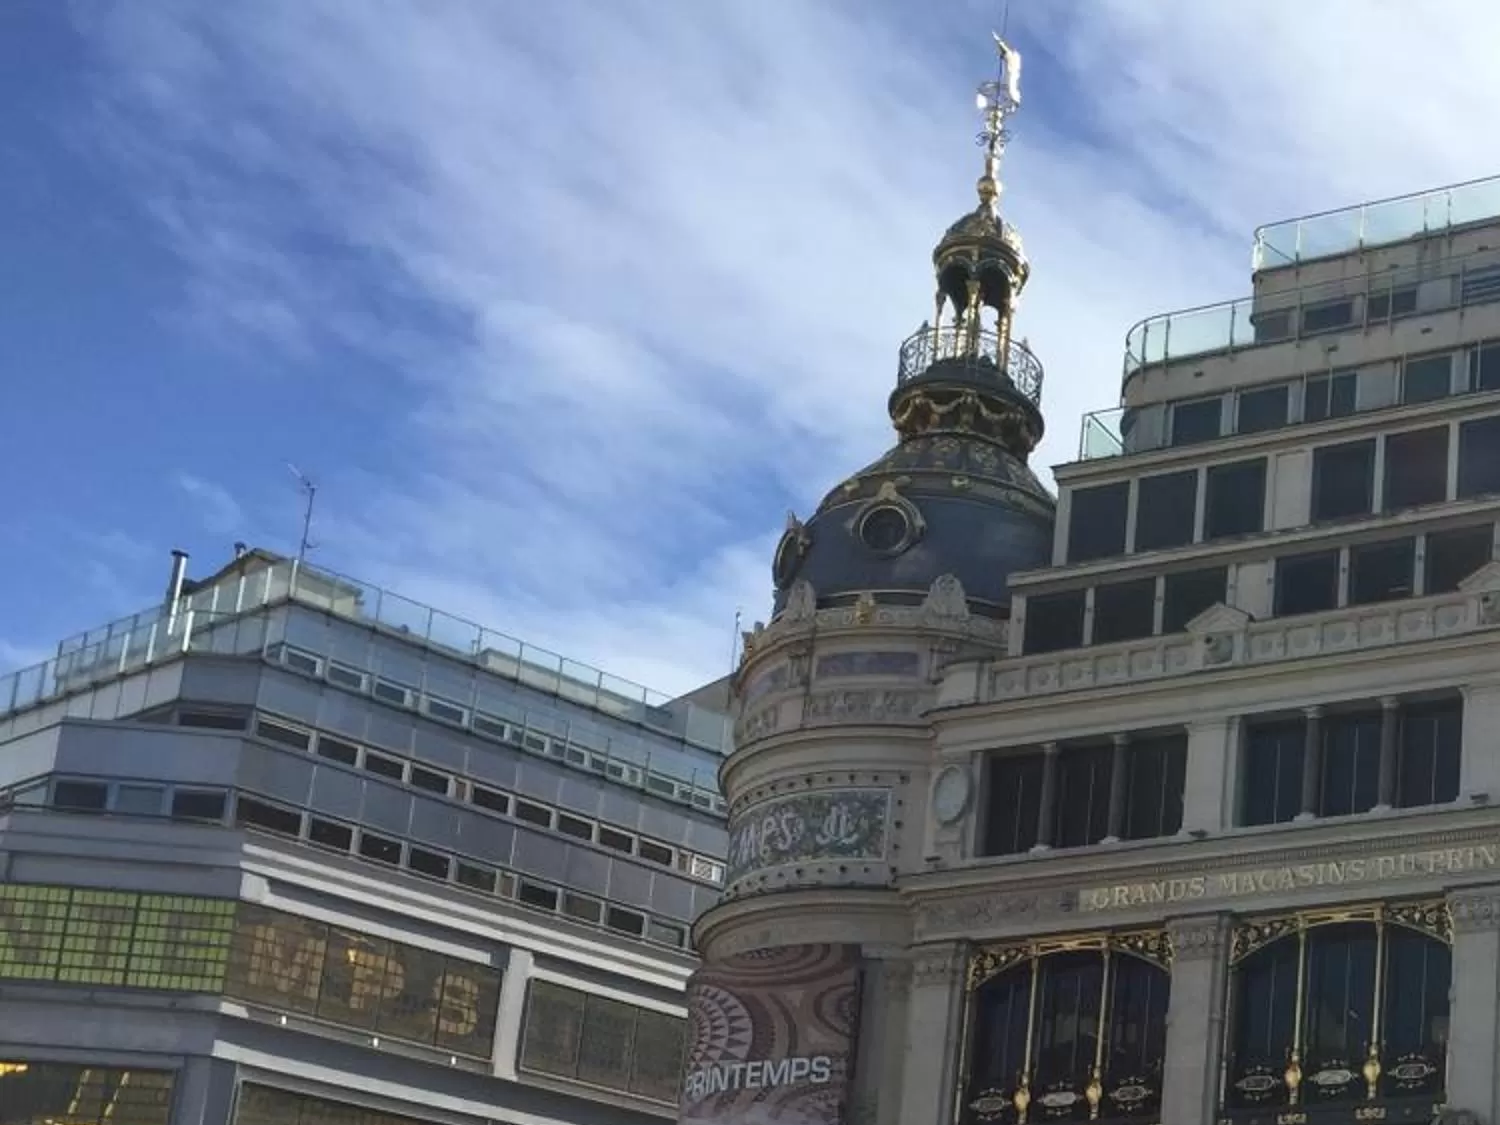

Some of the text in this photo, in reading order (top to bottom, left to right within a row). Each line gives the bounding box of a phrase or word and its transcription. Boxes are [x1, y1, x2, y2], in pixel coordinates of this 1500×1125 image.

[1091, 876, 1206, 911] GRANDS
[1218, 857, 1366, 896] MAGASINS
[1376, 853, 1415, 881] DU
[686, 1056, 832, 1102] PRINTEMPS
